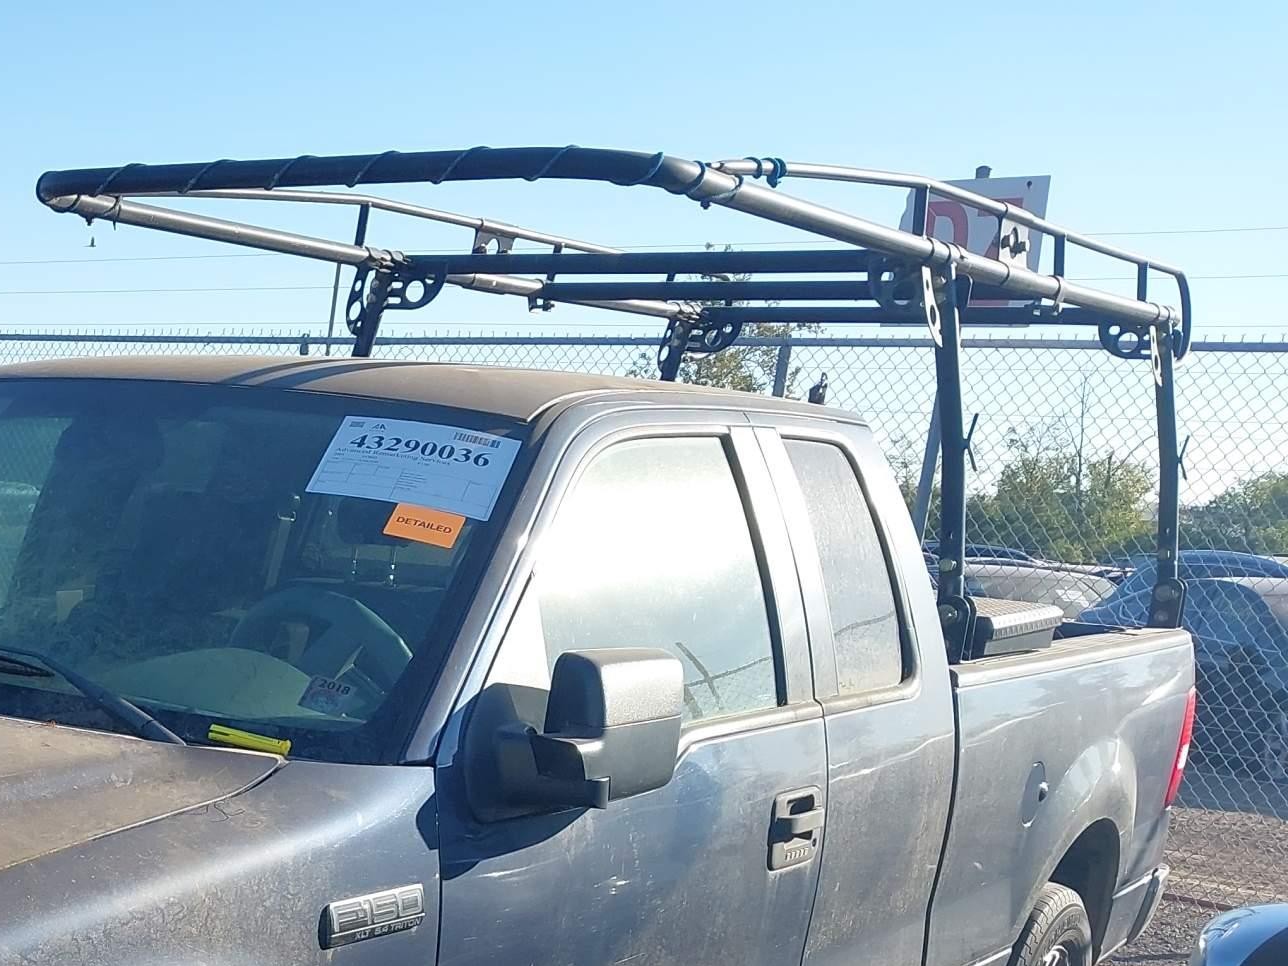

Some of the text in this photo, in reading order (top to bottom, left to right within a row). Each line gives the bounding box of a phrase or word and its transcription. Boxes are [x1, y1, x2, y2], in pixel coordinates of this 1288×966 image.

[349, 433, 492, 467] 43290036
[396, 516, 452, 534] DETAILED
[317, 678, 351, 695] 2018
[354, 929, 372, 940] XLT
[390, 917, 421, 931] TRITON
